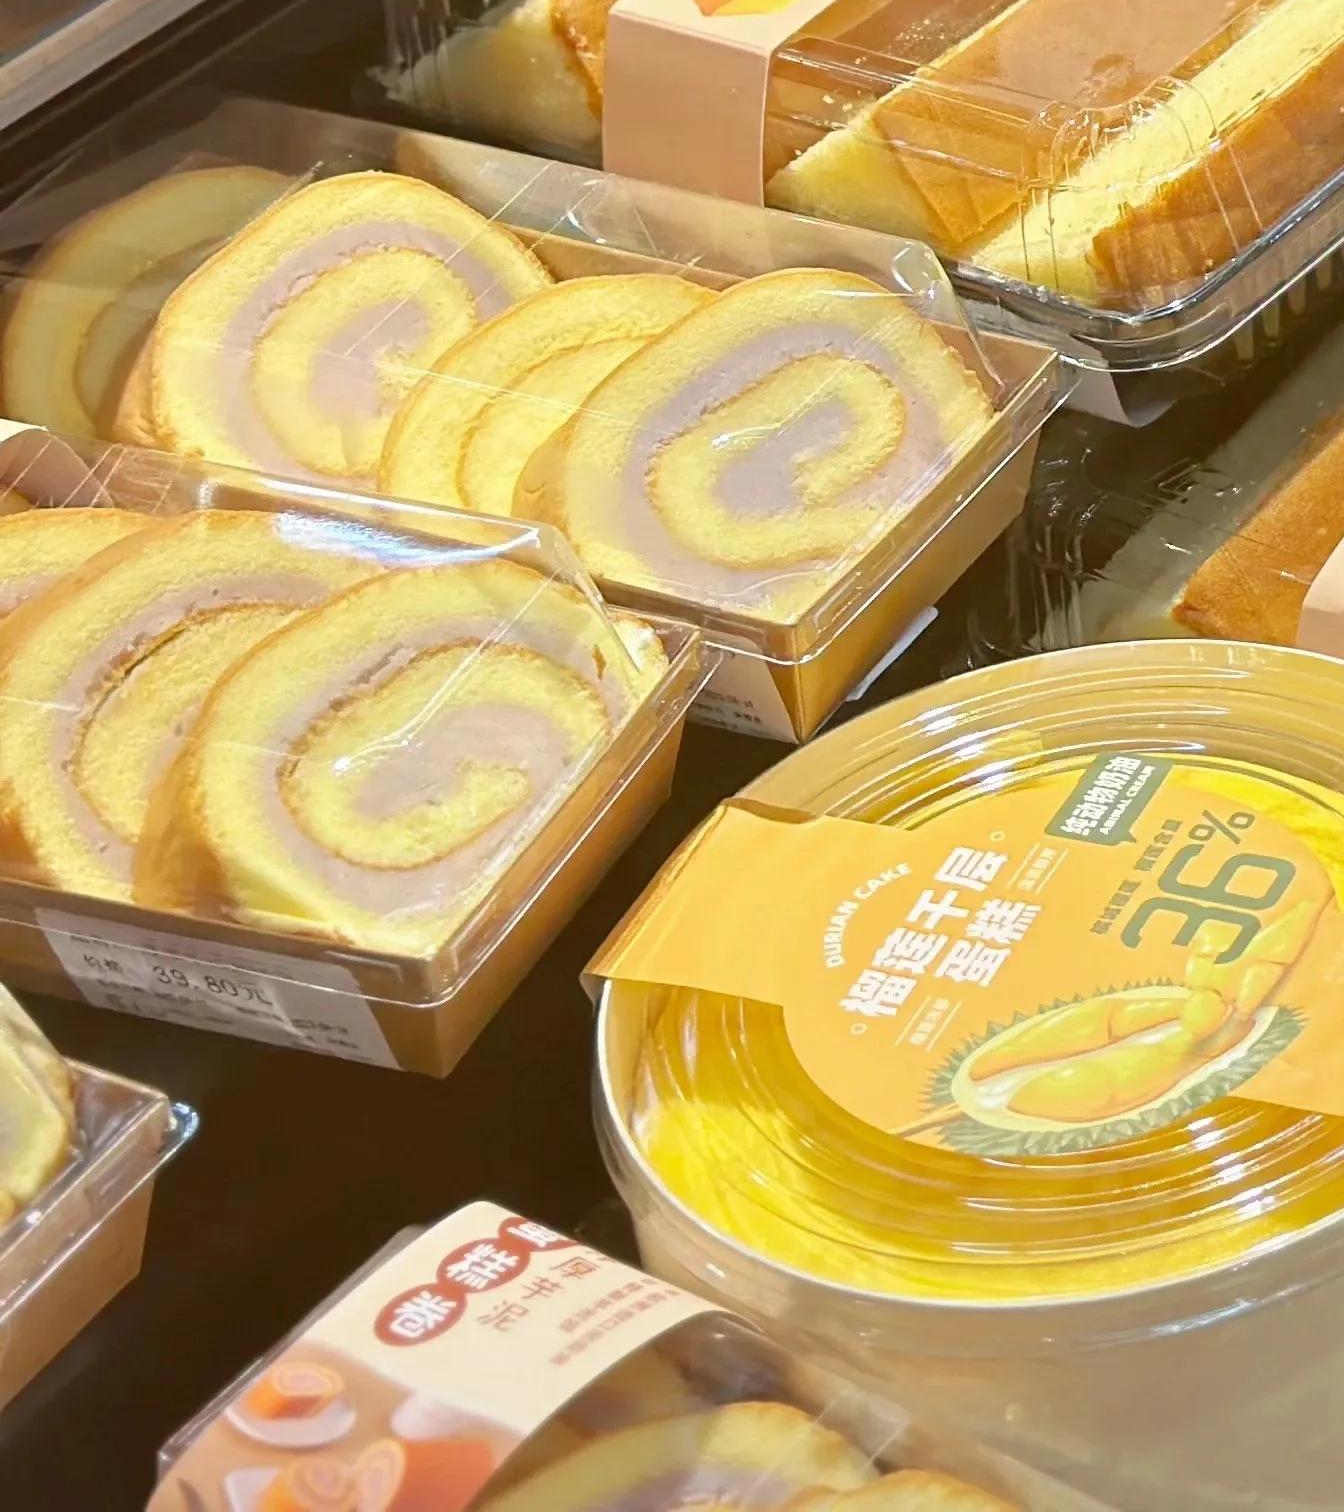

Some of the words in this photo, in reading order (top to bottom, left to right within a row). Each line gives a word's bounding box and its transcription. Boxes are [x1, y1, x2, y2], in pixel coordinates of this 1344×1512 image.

[1060, 755, 1143, 837] 纯动物奶油
[857, 861, 913, 900] CAKE
[1119, 808, 1297, 966] 36%
[839, 845, 1010, 1018] 榴莲千层
[934, 896, 1043, 988] 蛋糕
[476, 1250, 612, 1333] 厚芋泥
